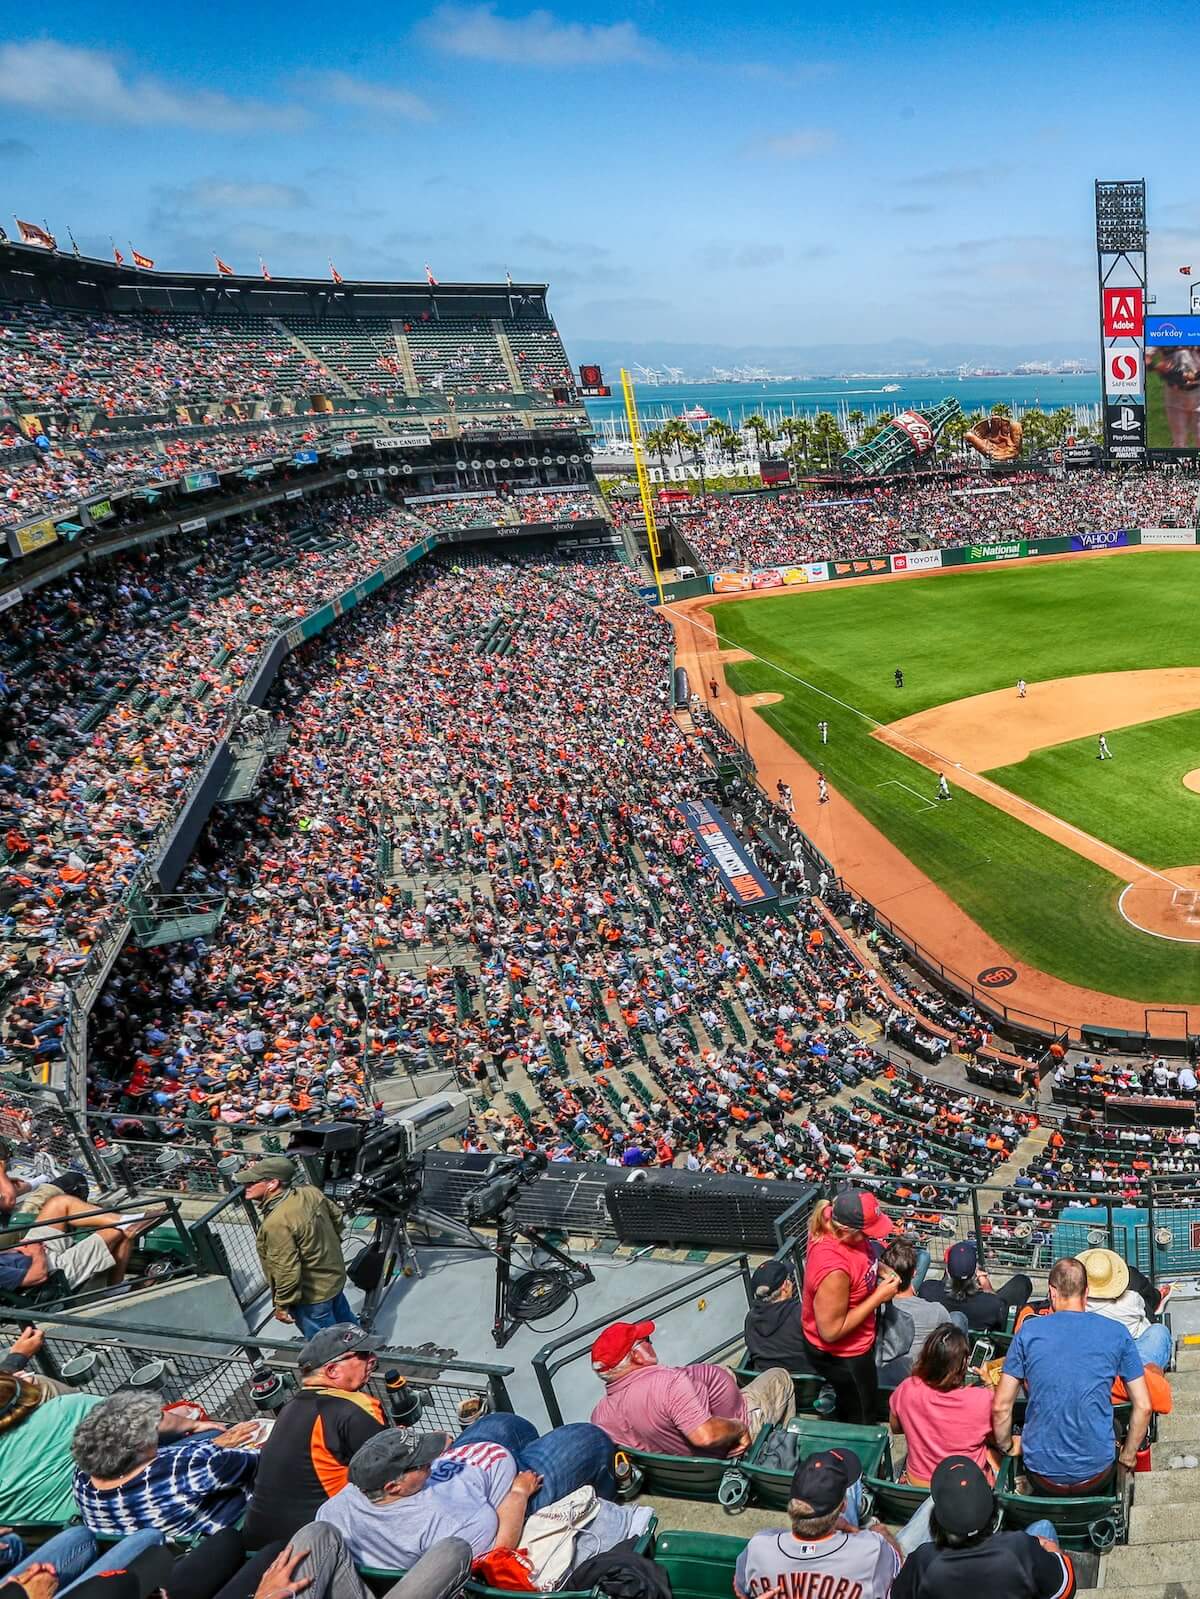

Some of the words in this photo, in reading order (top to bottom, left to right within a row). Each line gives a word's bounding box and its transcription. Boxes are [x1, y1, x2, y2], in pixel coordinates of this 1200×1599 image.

[1113, 320, 1135, 329] Adobe
[1150, 329, 1183, 338] workday
[376, 438, 399, 447] See's
[400, 438, 428, 446] CANDIES
[647, 462, 759, 483] nuveen
[497, 527, 521, 536] xfinity
[552, 523, 575, 531] xfinity
[1080, 531, 1118, 545] YAHOO!
[982, 543, 1019, 555] National
[910, 556, 939, 564] TOYOTA
